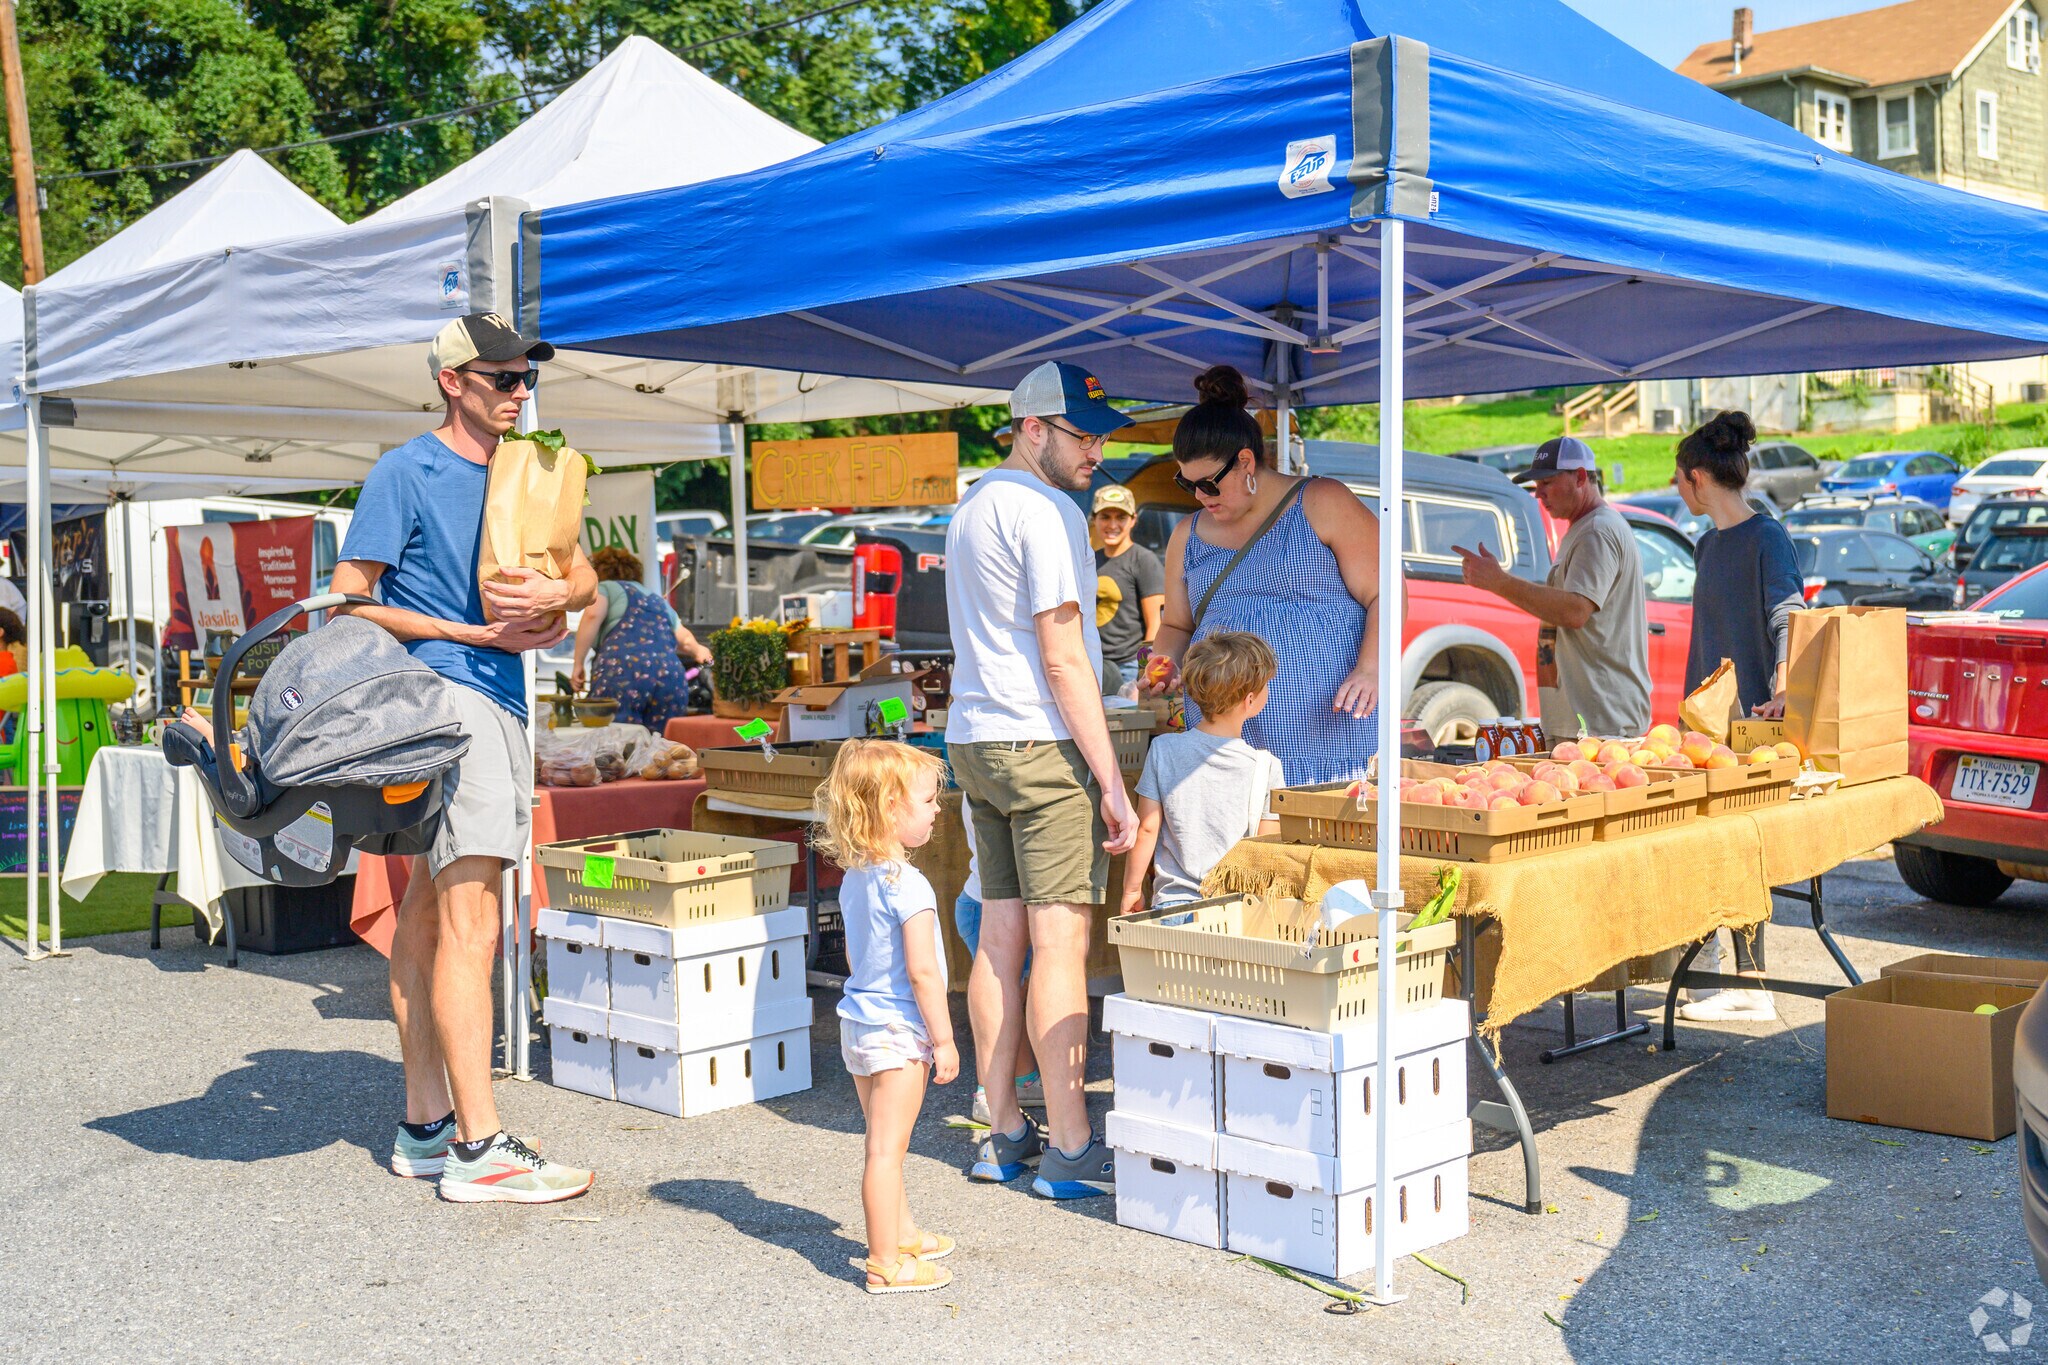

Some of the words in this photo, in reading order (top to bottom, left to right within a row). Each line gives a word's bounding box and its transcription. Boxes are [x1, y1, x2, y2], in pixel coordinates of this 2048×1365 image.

[755, 449, 842, 506] CREEK
[851, 443, 908, 503] FED
[912, 477, 951, 499] FARM
[584, 514, 639, 554] DAY
[258, 546, 284, 560] Inspired
[284, 546, 294, 559] by
[260, 559, 296, 571] Traditional
[263, 575, 297, 585] Moroccan
[198, 609, 239, 628] Jasalia
[246, 643, 280, 657] BUSH
[247, 655, 276, 670] POT
[722, 651, 771, 682] BUSH
[1737, 726, 1747, 736] 12
[1980, 760, 2017, 772] VIRGINIA
[1961, 767, 2031, 795] TTX-7529
